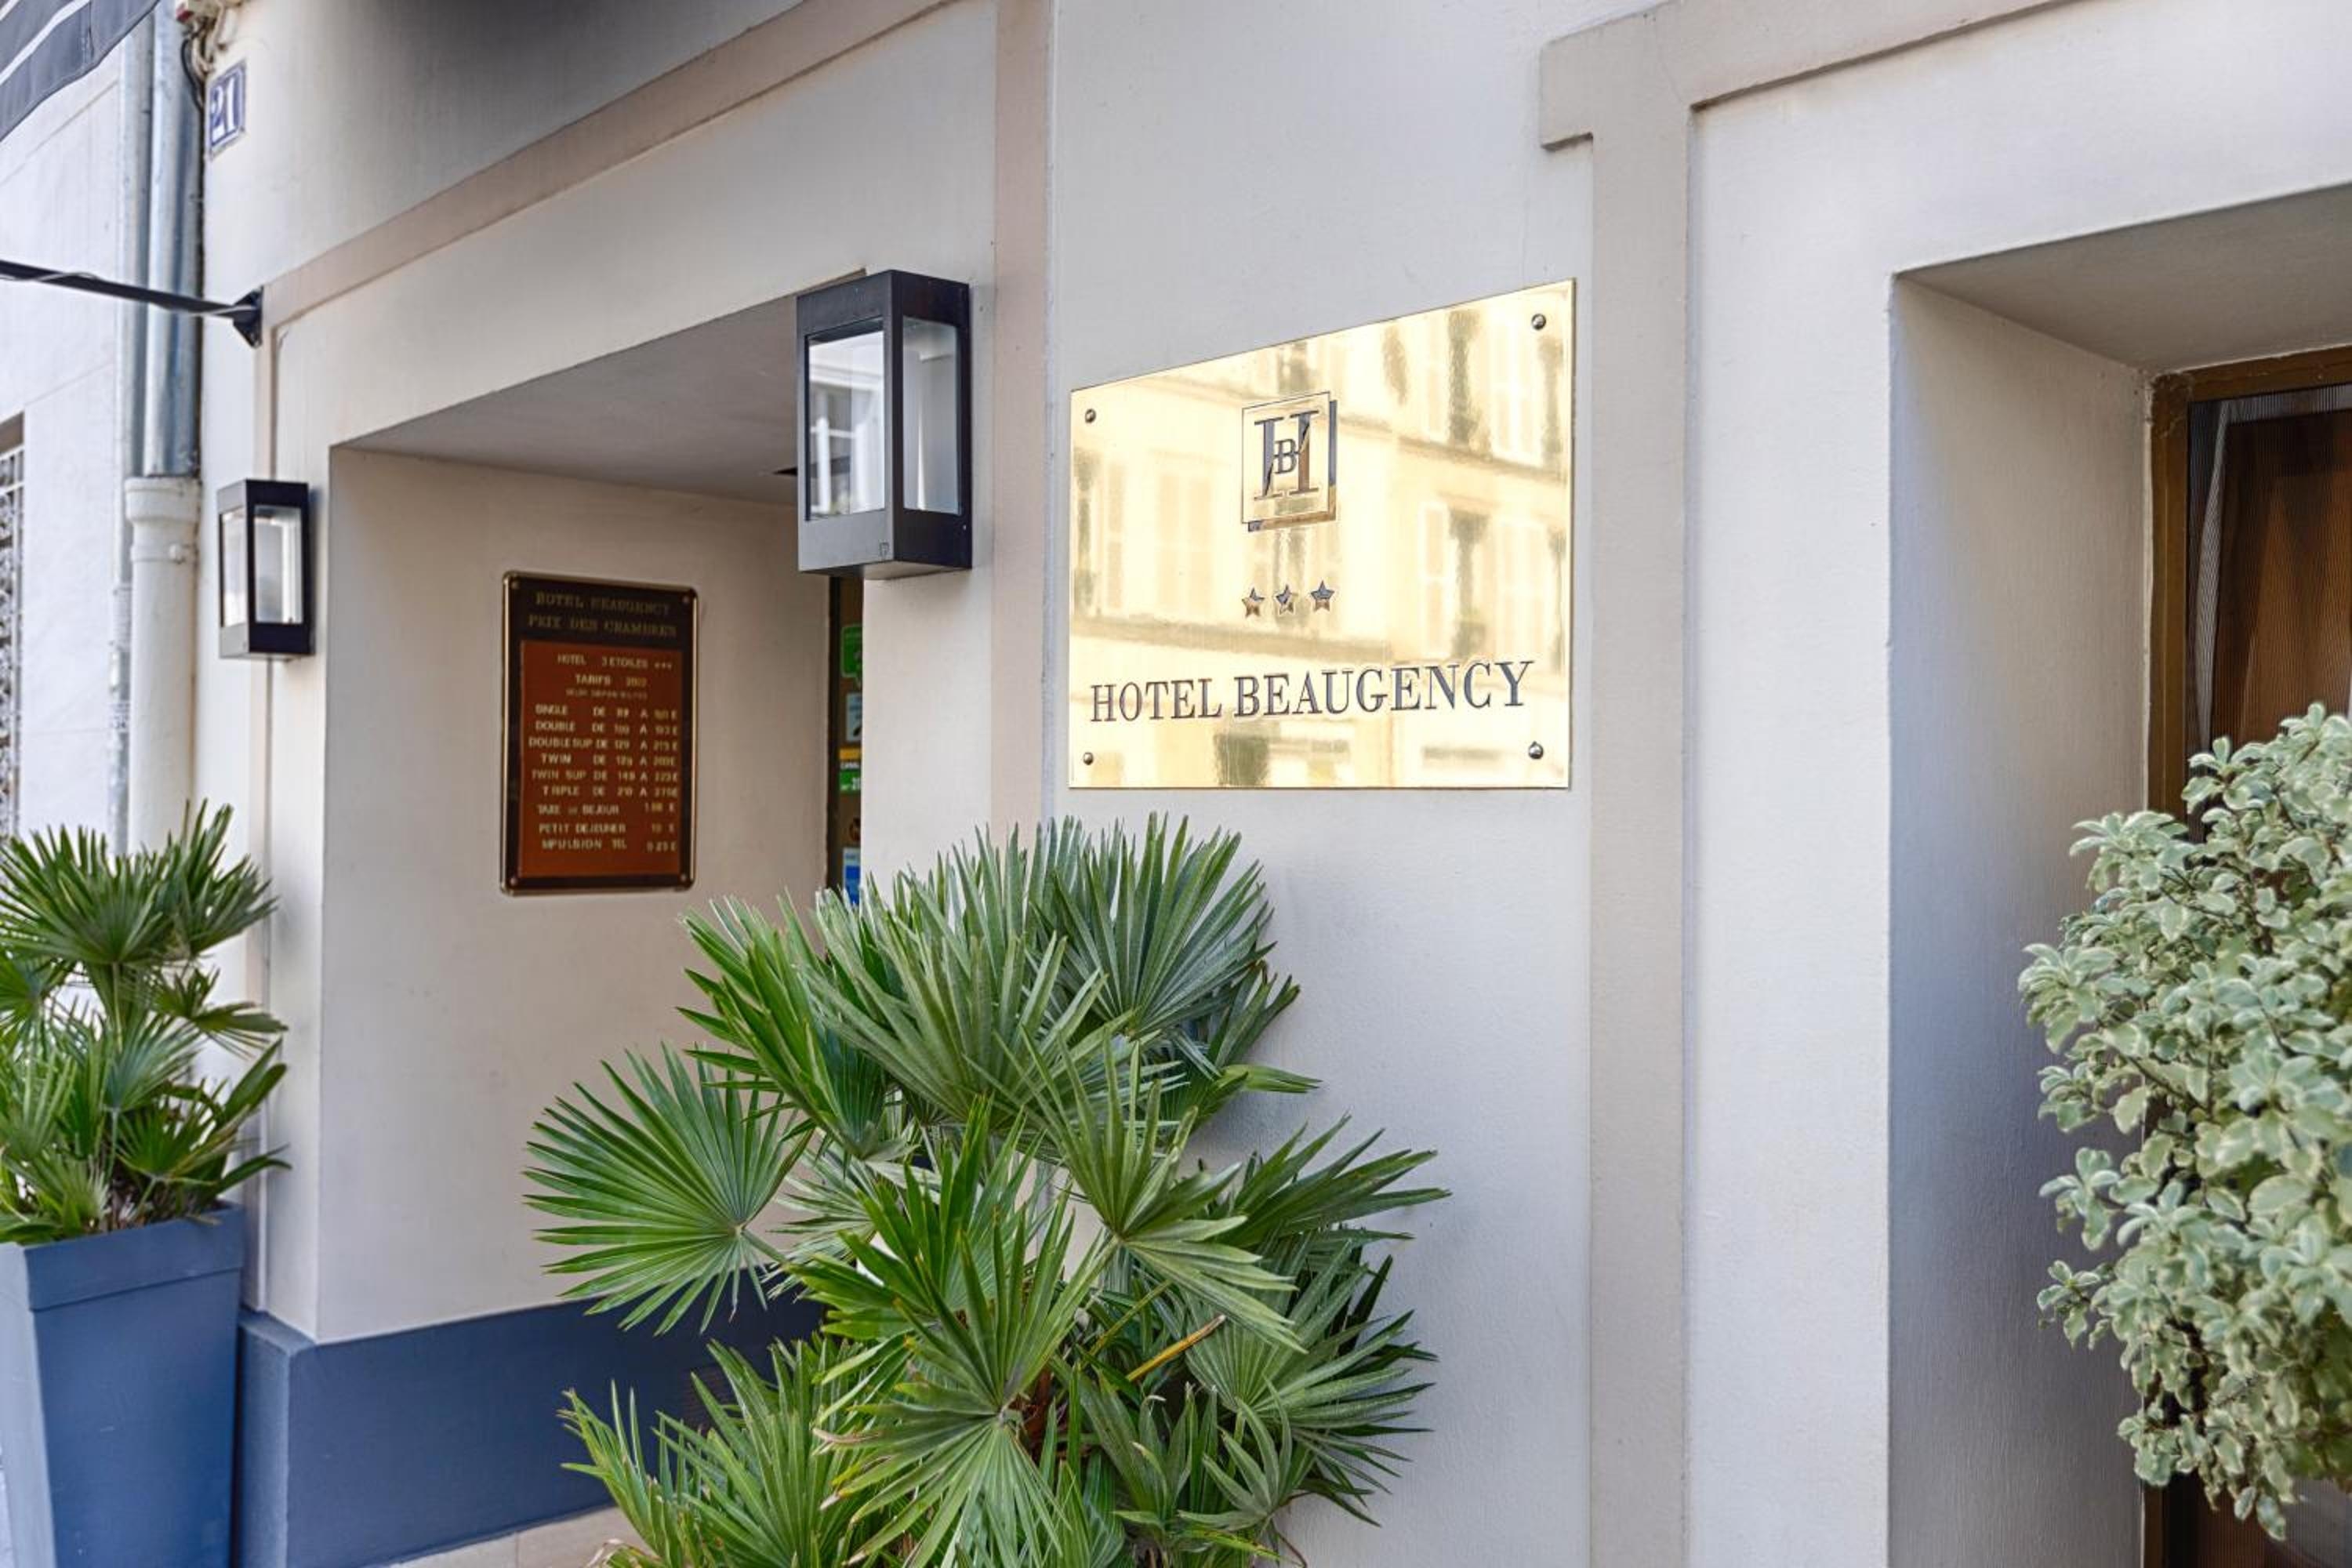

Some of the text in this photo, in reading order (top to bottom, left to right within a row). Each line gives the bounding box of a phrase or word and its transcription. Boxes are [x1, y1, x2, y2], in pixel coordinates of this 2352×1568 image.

[211, 77, 235, 143] 21
[1090, 659, 1535, 723] HOTEL BEAUGENCY
[535, 720, 576, 732] DOUBLE
[528, 737, 570, 749] DOUBLE
[541, 753, 572, 764] TWIN
[532, 769, 559, 780] TWIN
